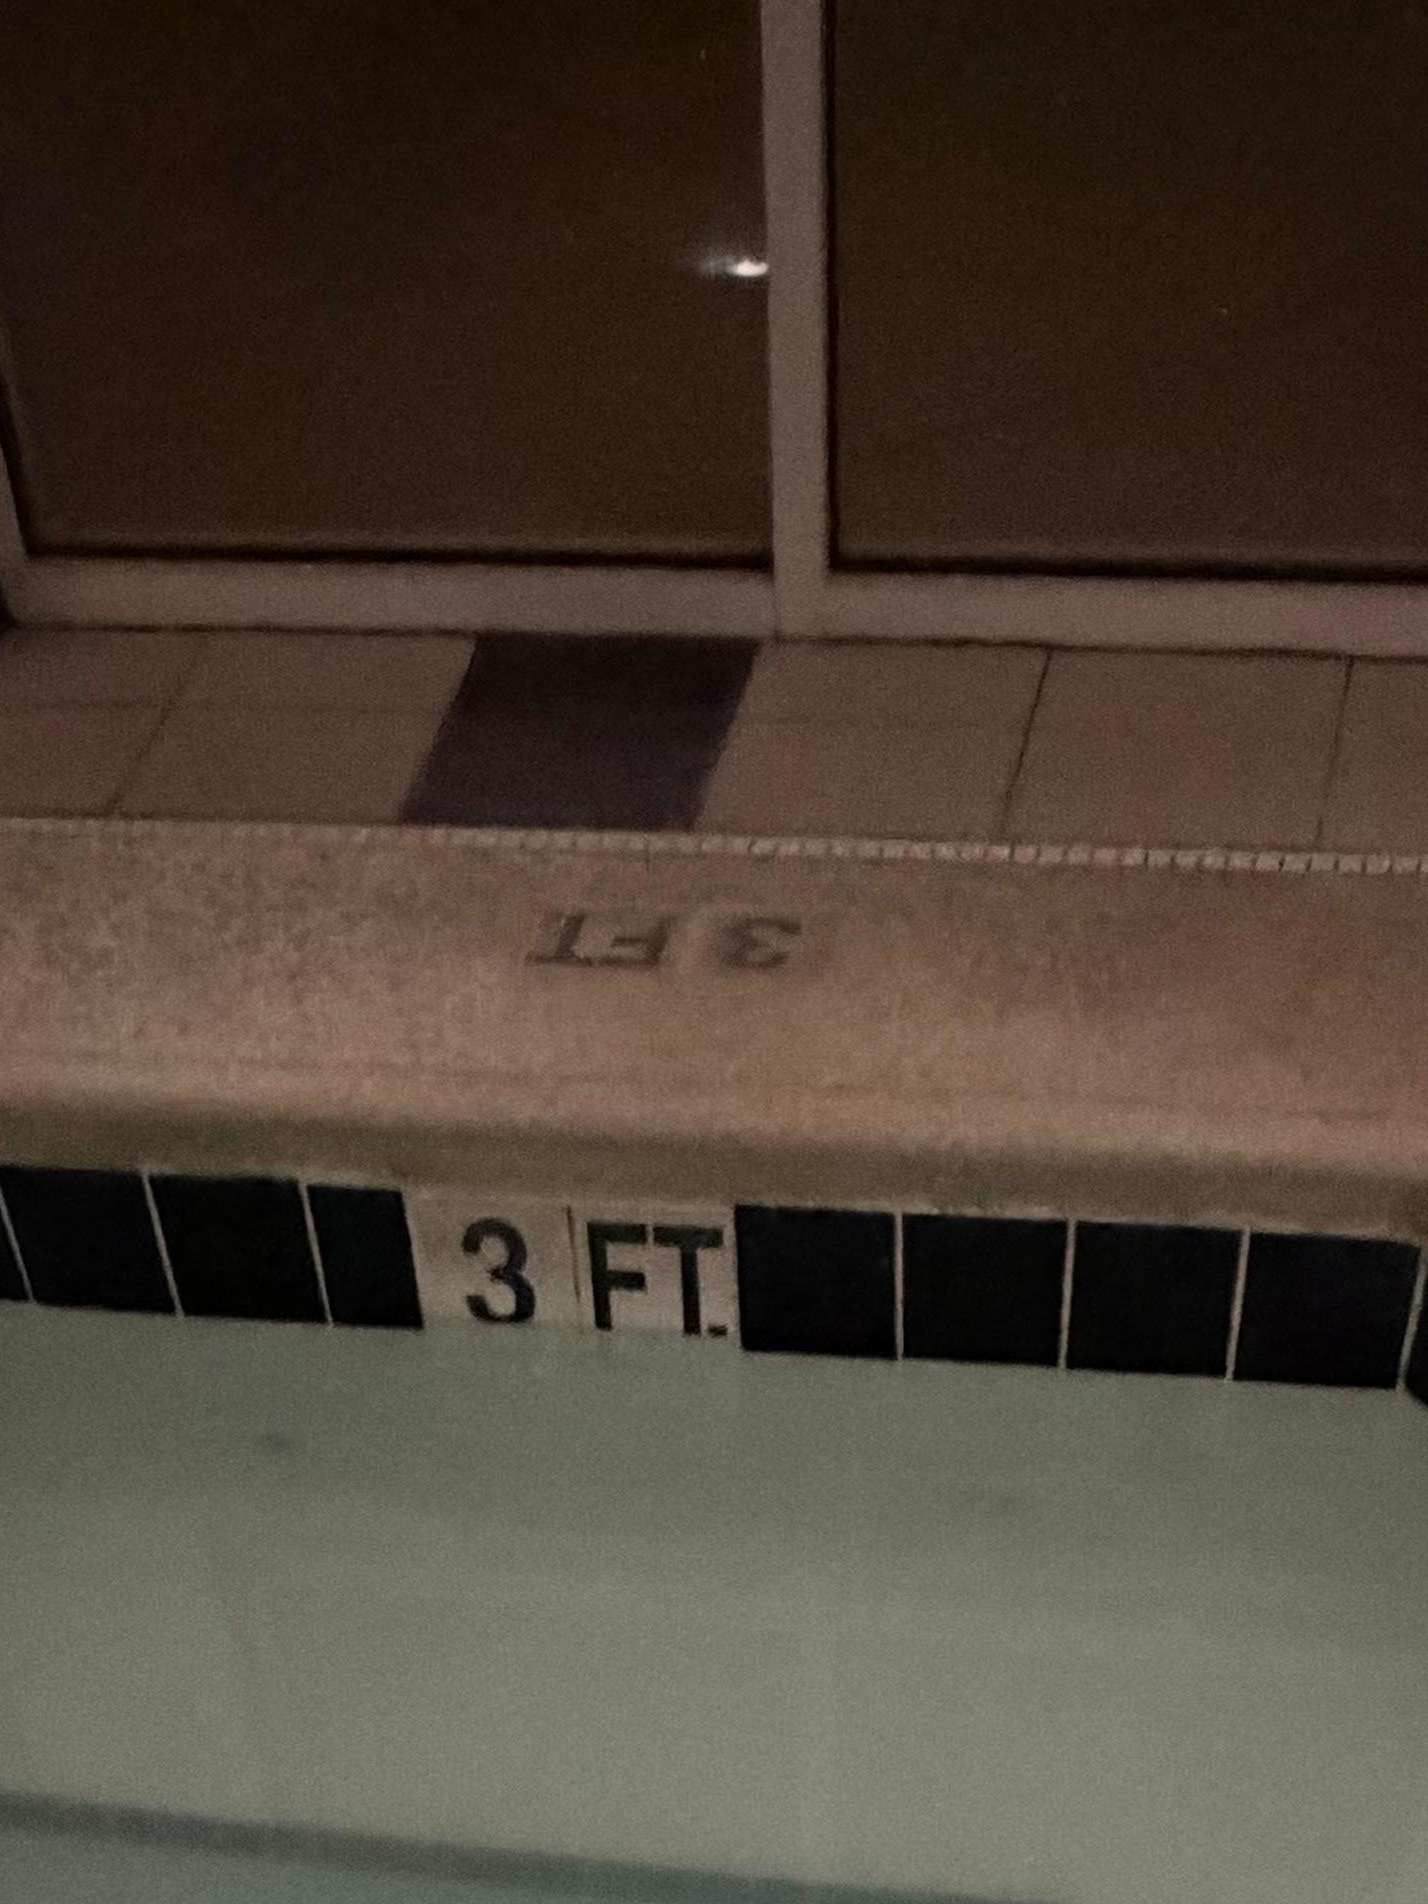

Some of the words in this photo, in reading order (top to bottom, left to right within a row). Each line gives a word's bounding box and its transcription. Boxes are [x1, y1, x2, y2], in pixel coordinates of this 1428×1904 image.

[715, 912, 803, 970] 3
[460, 1216, 536, 1324] 3
[585, 1219, 729, 1338] FT.
